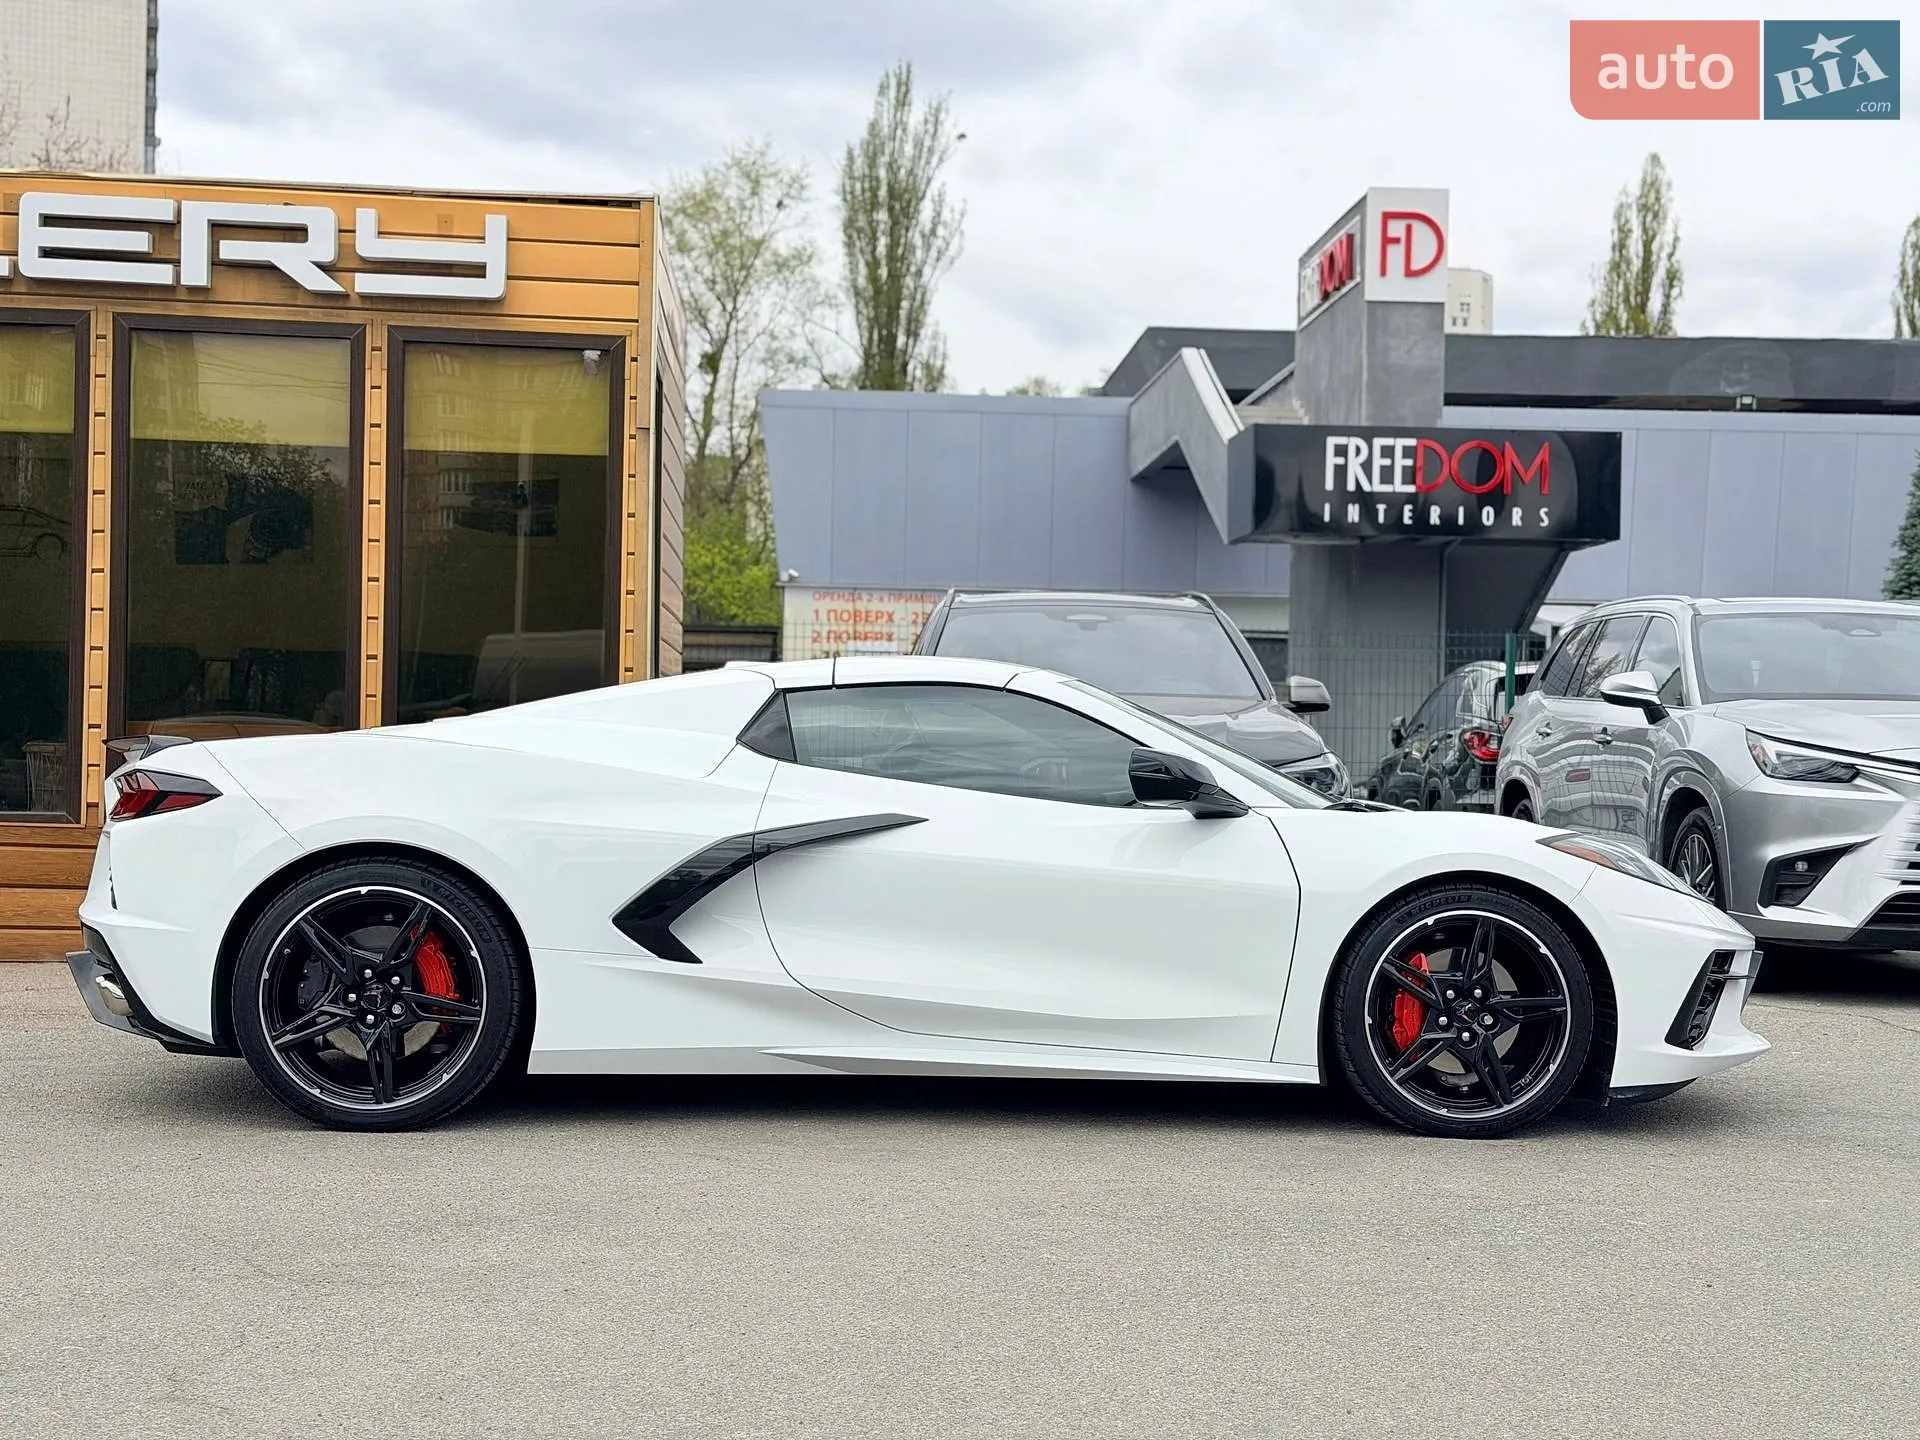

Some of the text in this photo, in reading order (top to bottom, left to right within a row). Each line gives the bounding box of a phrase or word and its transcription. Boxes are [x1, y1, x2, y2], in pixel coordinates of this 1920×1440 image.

[0, 191, 508, 301] ERY
[1379, 211, 1445, 278] FD
[1324, 436, 1550, 496] FREEDOM
[1323, 502, 1550, 527] INTERIORS
[812, 591, 864, 602] ОРЕНДА
[814, 608, 820, 621] 1
[826, 608, 895, 624] ПОВЕРХ
[811, 629, 822, 644] 2
